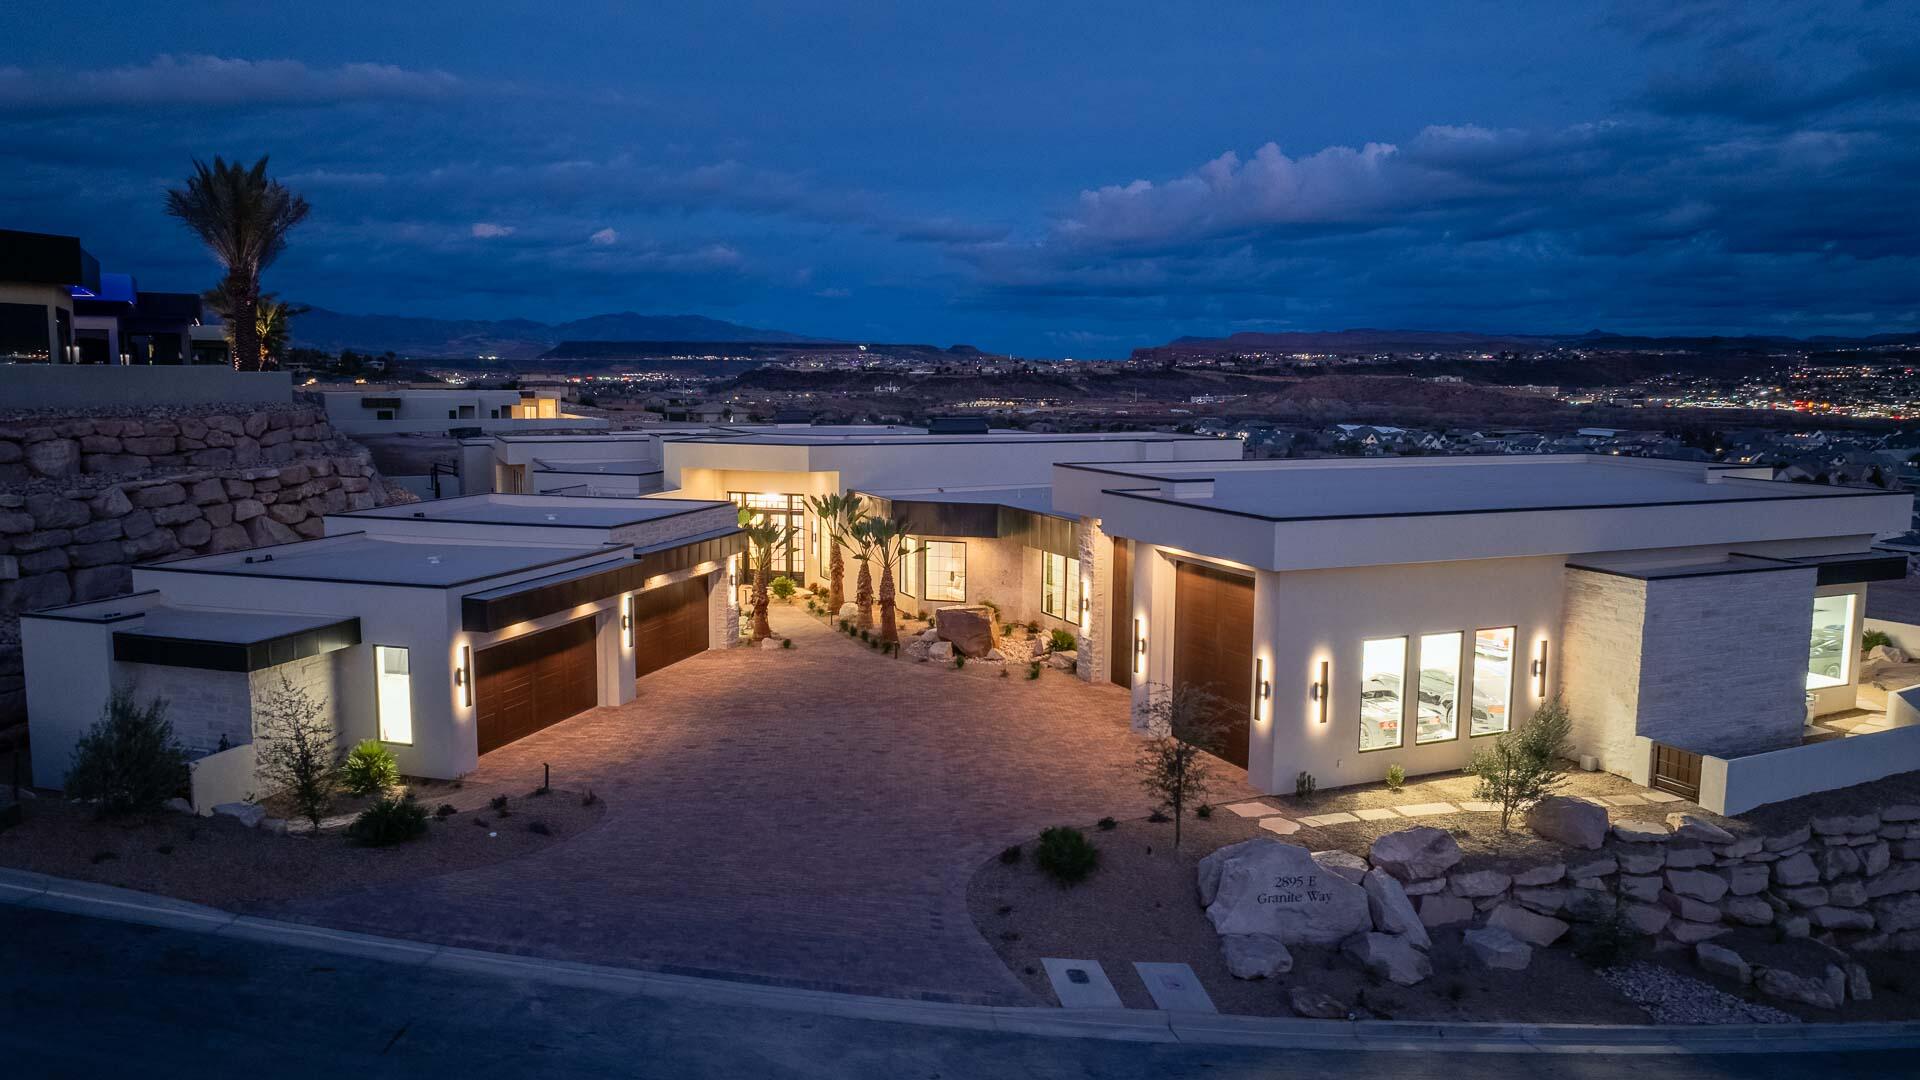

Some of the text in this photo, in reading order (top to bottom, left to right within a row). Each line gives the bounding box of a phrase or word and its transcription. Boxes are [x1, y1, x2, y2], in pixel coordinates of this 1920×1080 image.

[1275, 876, 1317, 888] 2895 E
[1257, 890, 1332, 904] Granite Way
